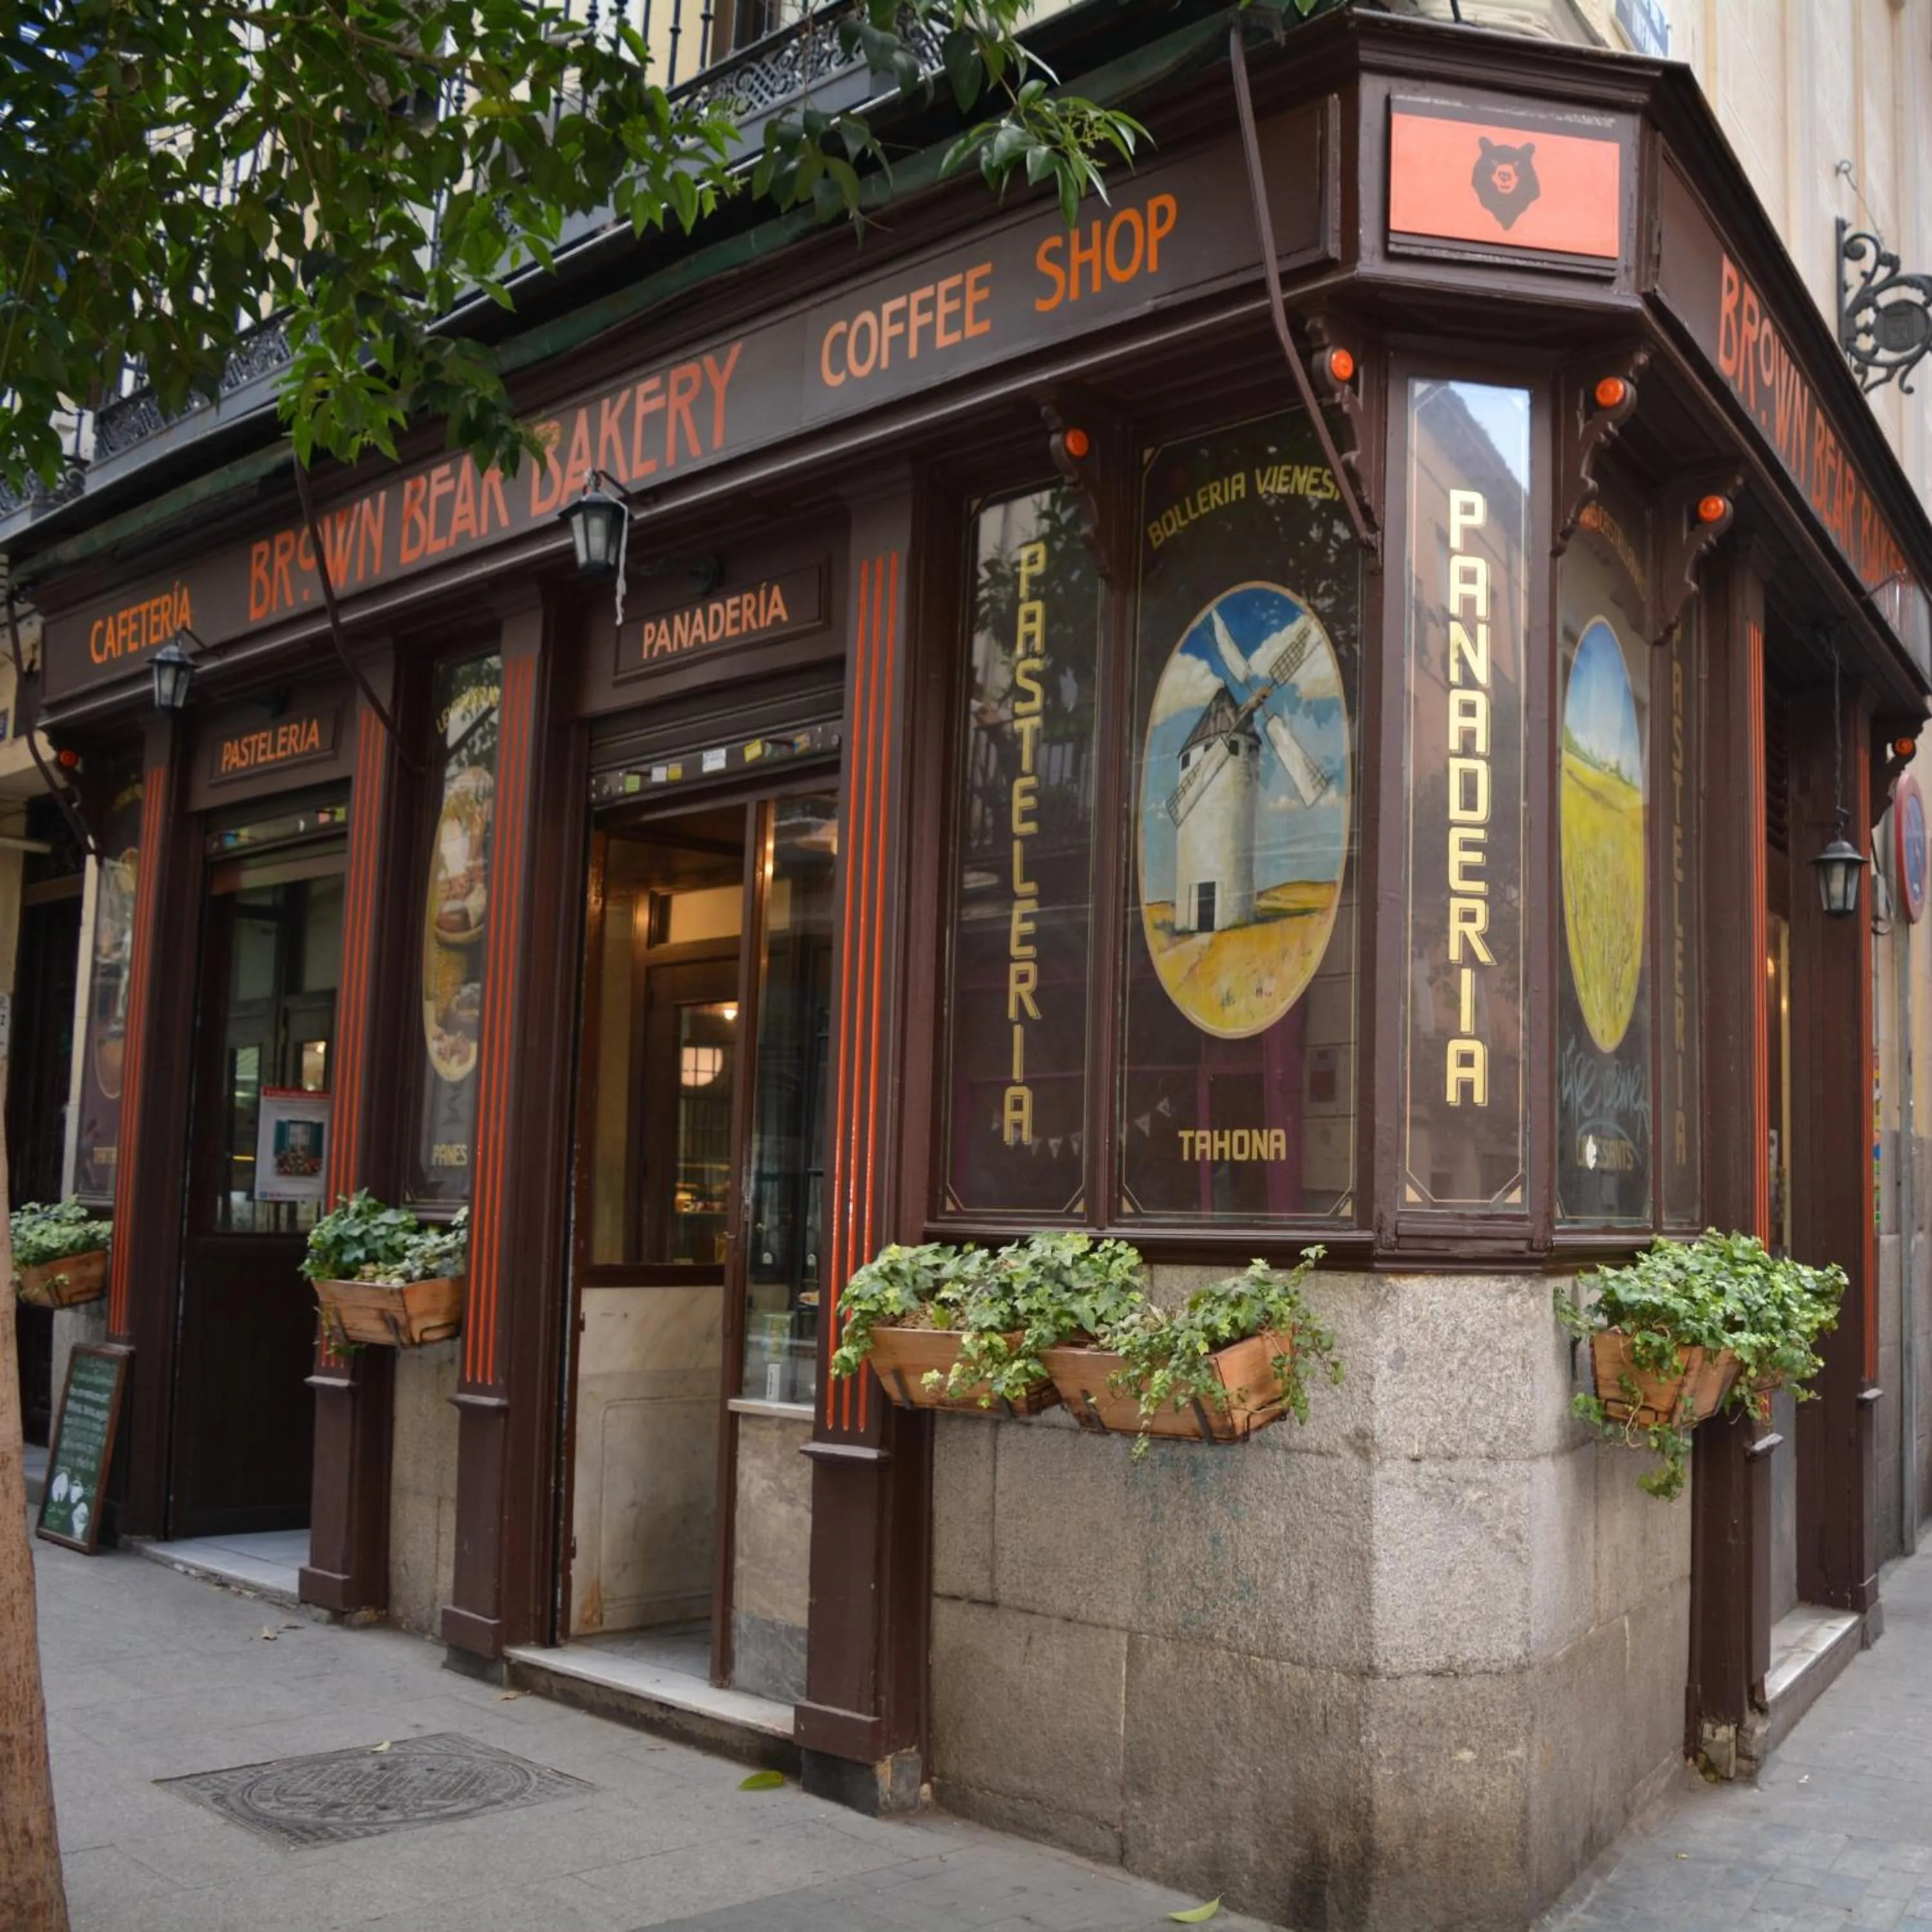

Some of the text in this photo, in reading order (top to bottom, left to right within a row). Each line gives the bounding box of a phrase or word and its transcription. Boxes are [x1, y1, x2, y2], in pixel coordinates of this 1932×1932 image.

[821, 193, 1177, 387] COFFEE SHOP
[399, 453, 509, 565] BEAR
[530, 342, 743, 517] BAKERY
[1147, 464, 1340, 549] BOLLERIA VIENES
[1812, 405, 1855, 565] BEAR
[90, 580, 191, 664] CAFETERÍA
[643, 582, 788, 659] PANADERÍA
[1004, 541, 1047, 1146] PASTELERIA
[1446, 489, 1496, 1106] PANADERIA
[432, 1144, 468, 1166] PANES
[1178, 1128, 1287, 1161] TAHONA
